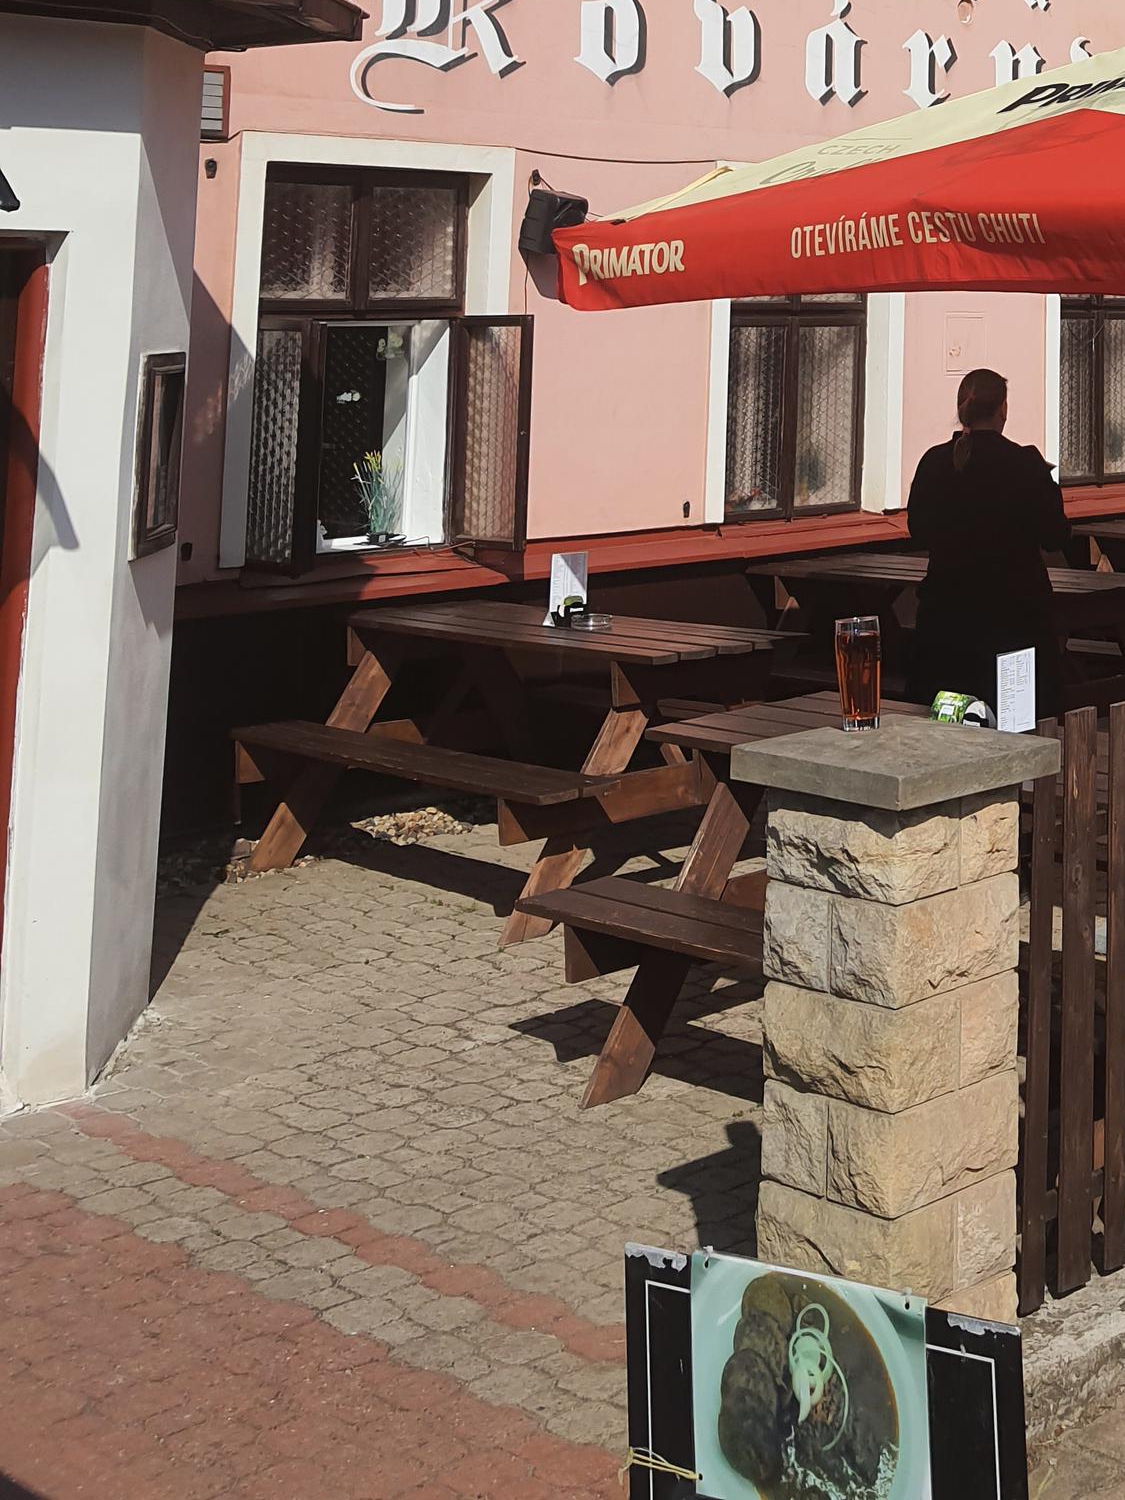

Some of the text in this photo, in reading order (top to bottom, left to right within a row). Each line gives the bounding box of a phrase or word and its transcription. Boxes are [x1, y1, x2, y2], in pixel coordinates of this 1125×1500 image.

[817, 143, 901, 156] CZECH
[790, 210, 1047, 259] OTEVÍRÁME CESTU CHUTI
[571, 239, 686, 287] PRIMATOR
